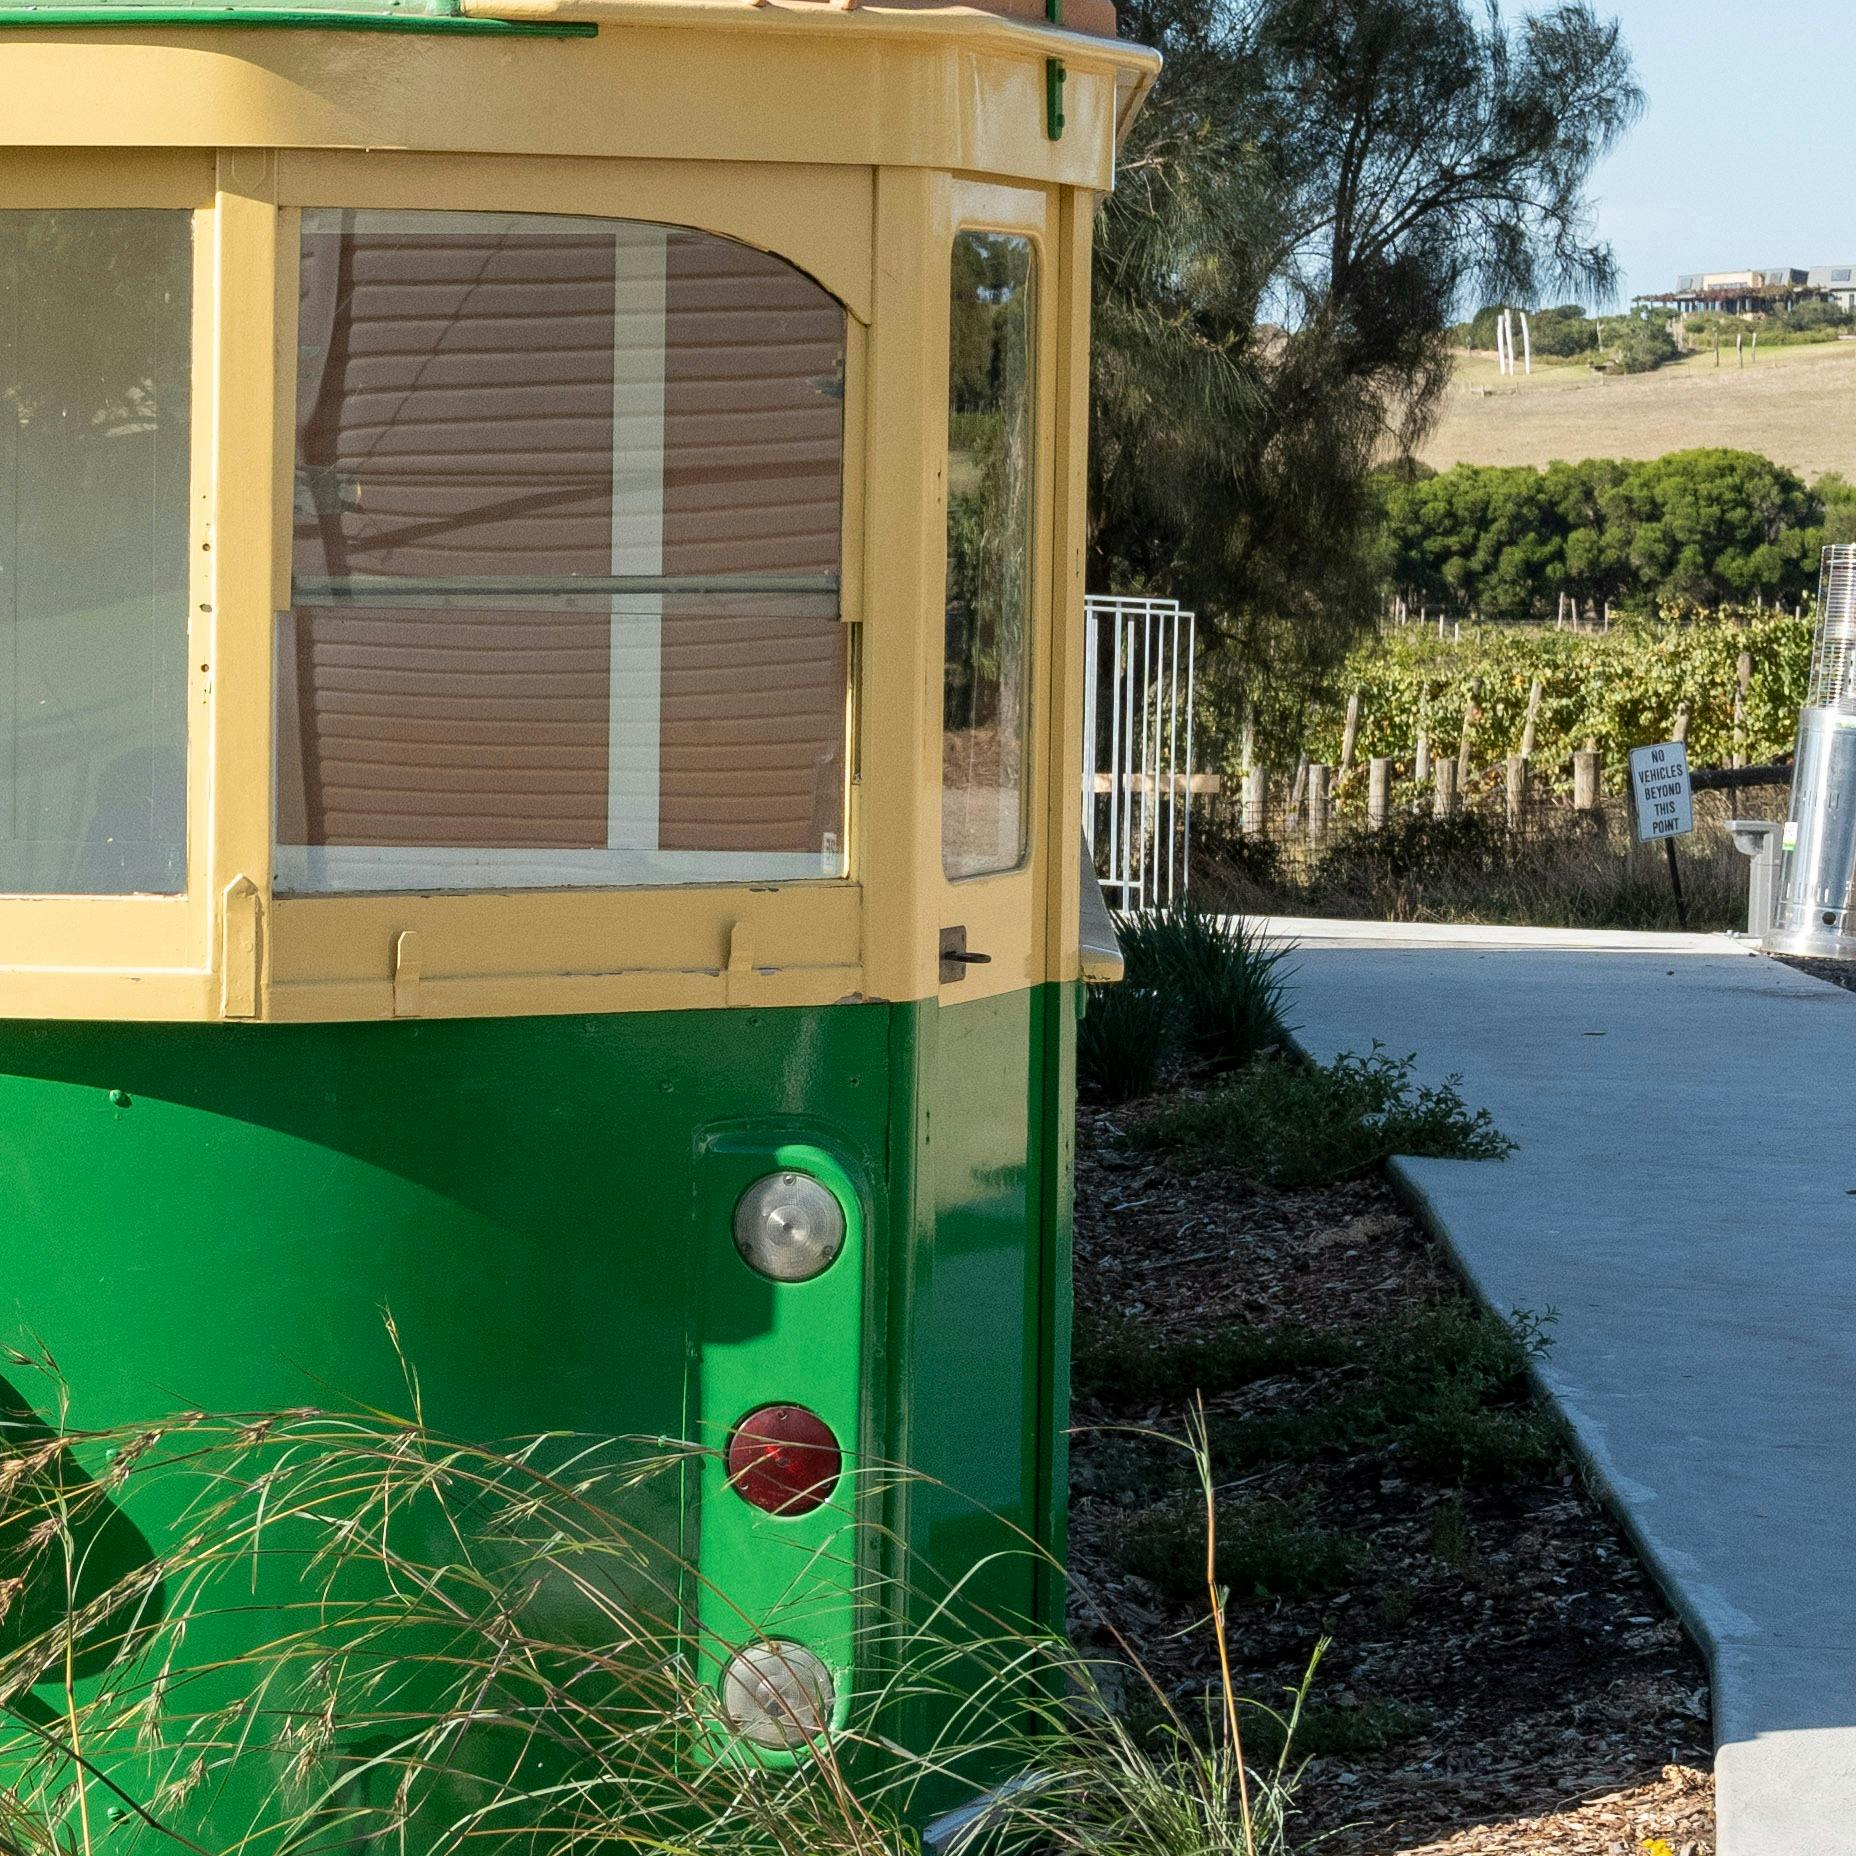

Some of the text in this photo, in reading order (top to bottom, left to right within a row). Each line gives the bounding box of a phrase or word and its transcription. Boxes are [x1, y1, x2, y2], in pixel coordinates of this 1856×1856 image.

[1651, 749, 1665, 763] NO
[1638, 764, 1684, 784] VEHICLES
[1644, 782, 1682, 800] BEYOND
[1654, 801, 1676, 817] THIS
[1652, 817, 1679, 835] POINT
